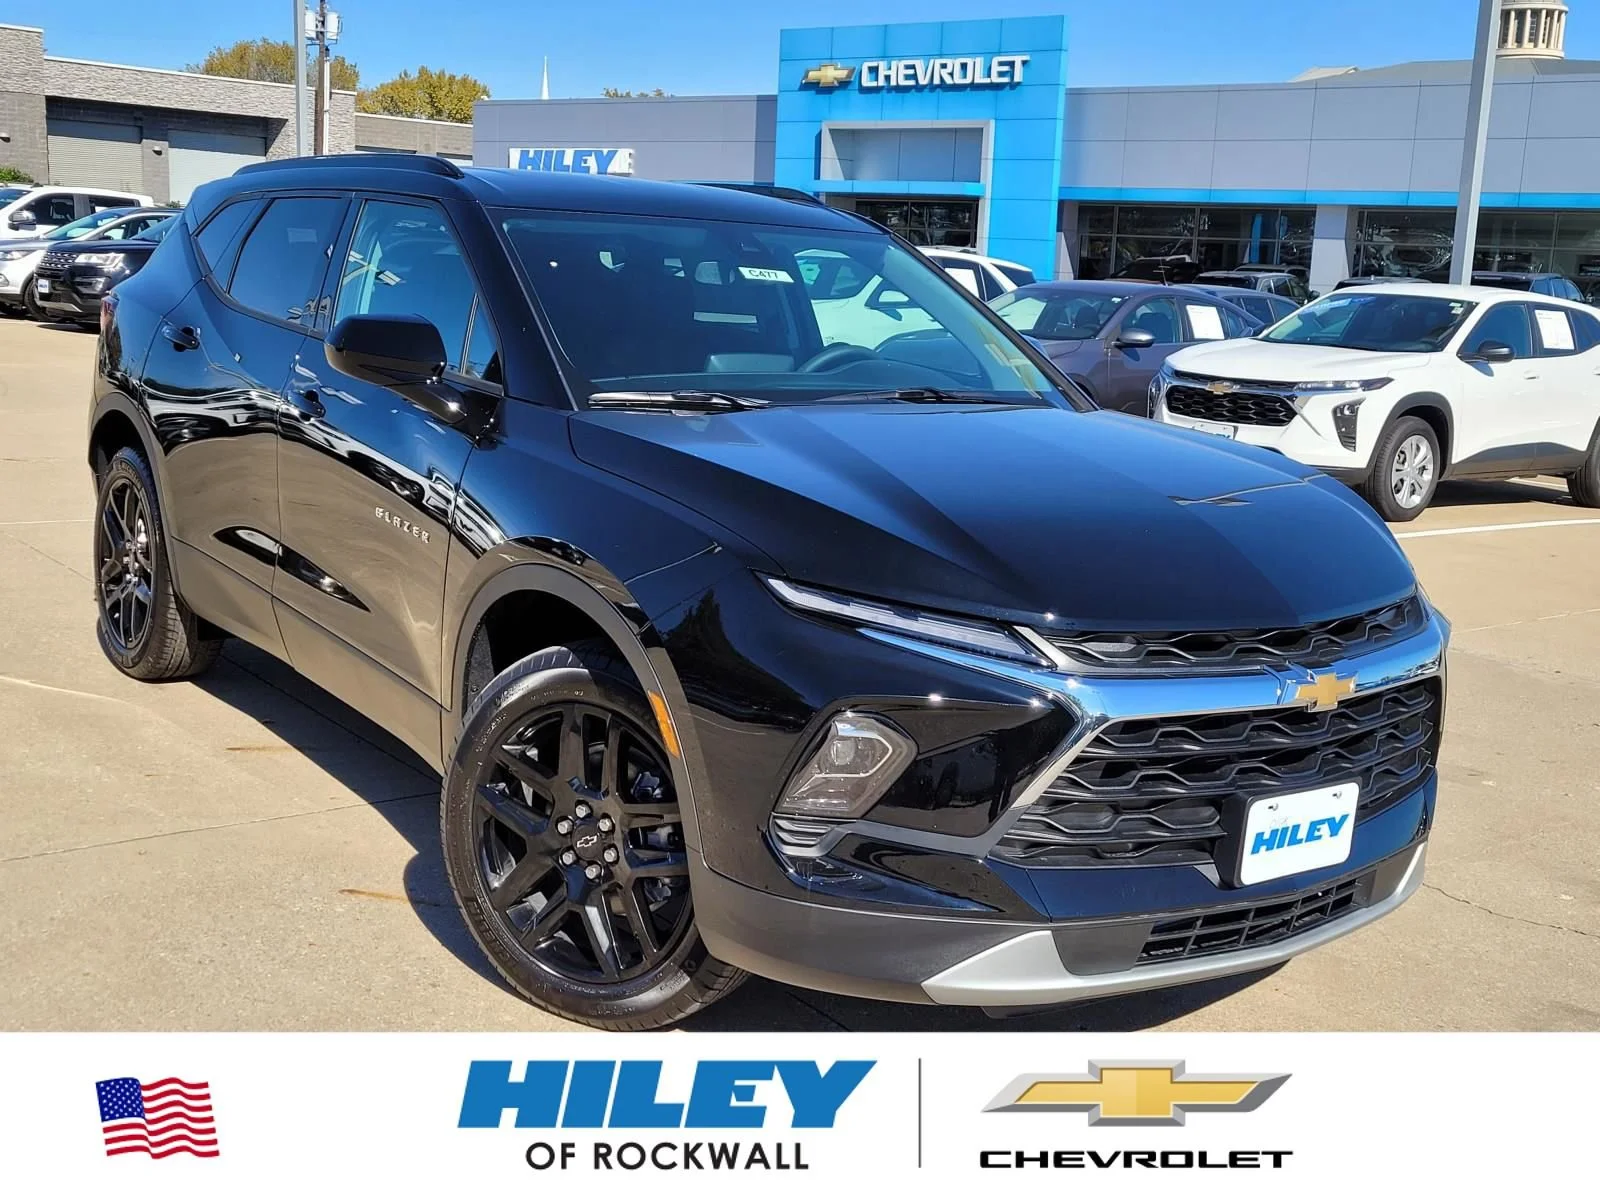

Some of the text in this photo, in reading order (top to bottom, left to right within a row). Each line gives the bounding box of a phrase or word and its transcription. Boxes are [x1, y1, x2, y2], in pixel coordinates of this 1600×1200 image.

[860, 54, 1030, 88] CHEVROLET
[518, 149, 620, 176] HILEY
[748, 268, 779, 279] C477
[375, 506, 430, 544] BLAZER
[1250, 813, 1350, 855] HILEY
